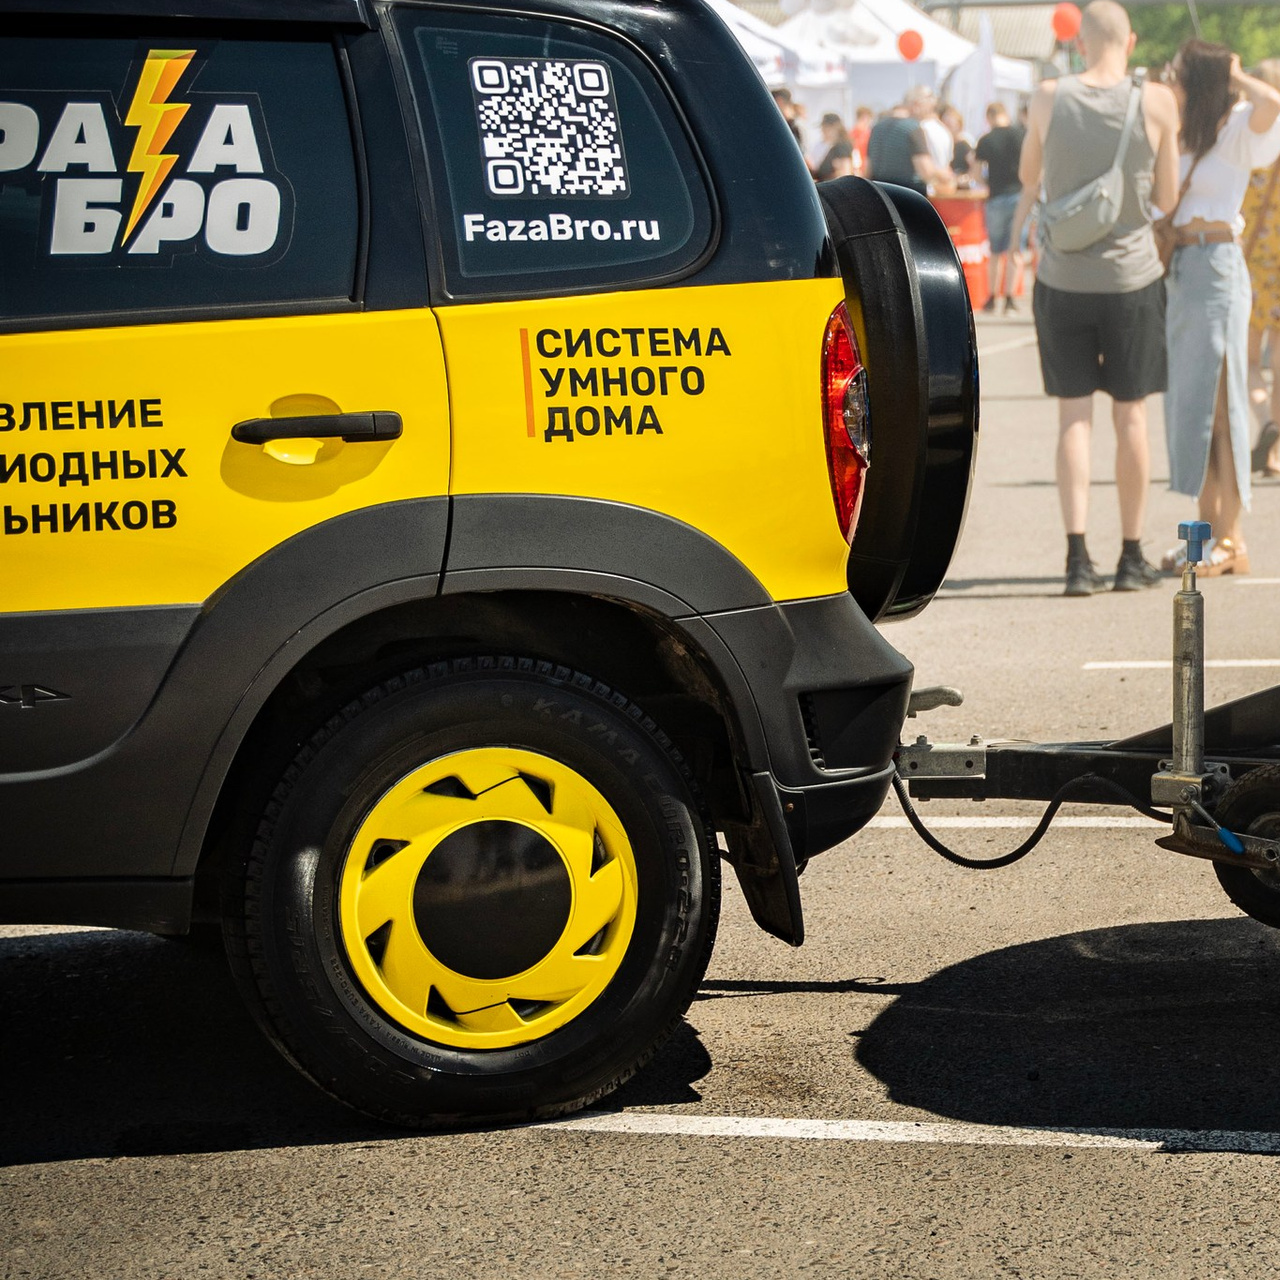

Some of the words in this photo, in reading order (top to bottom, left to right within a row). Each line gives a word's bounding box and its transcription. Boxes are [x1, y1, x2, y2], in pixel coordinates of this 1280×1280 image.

[50, 178, 280, 256] БРО
[463, 213, 661, 242] FazaBro.ru
[536, 327, 732, 358] СИСТЕМА
[539, 365, 706, 398] УМНОГО
[544, 405, 664, 442] ДОМА
[3, 499, 178, 535] ЬНИКОВ
